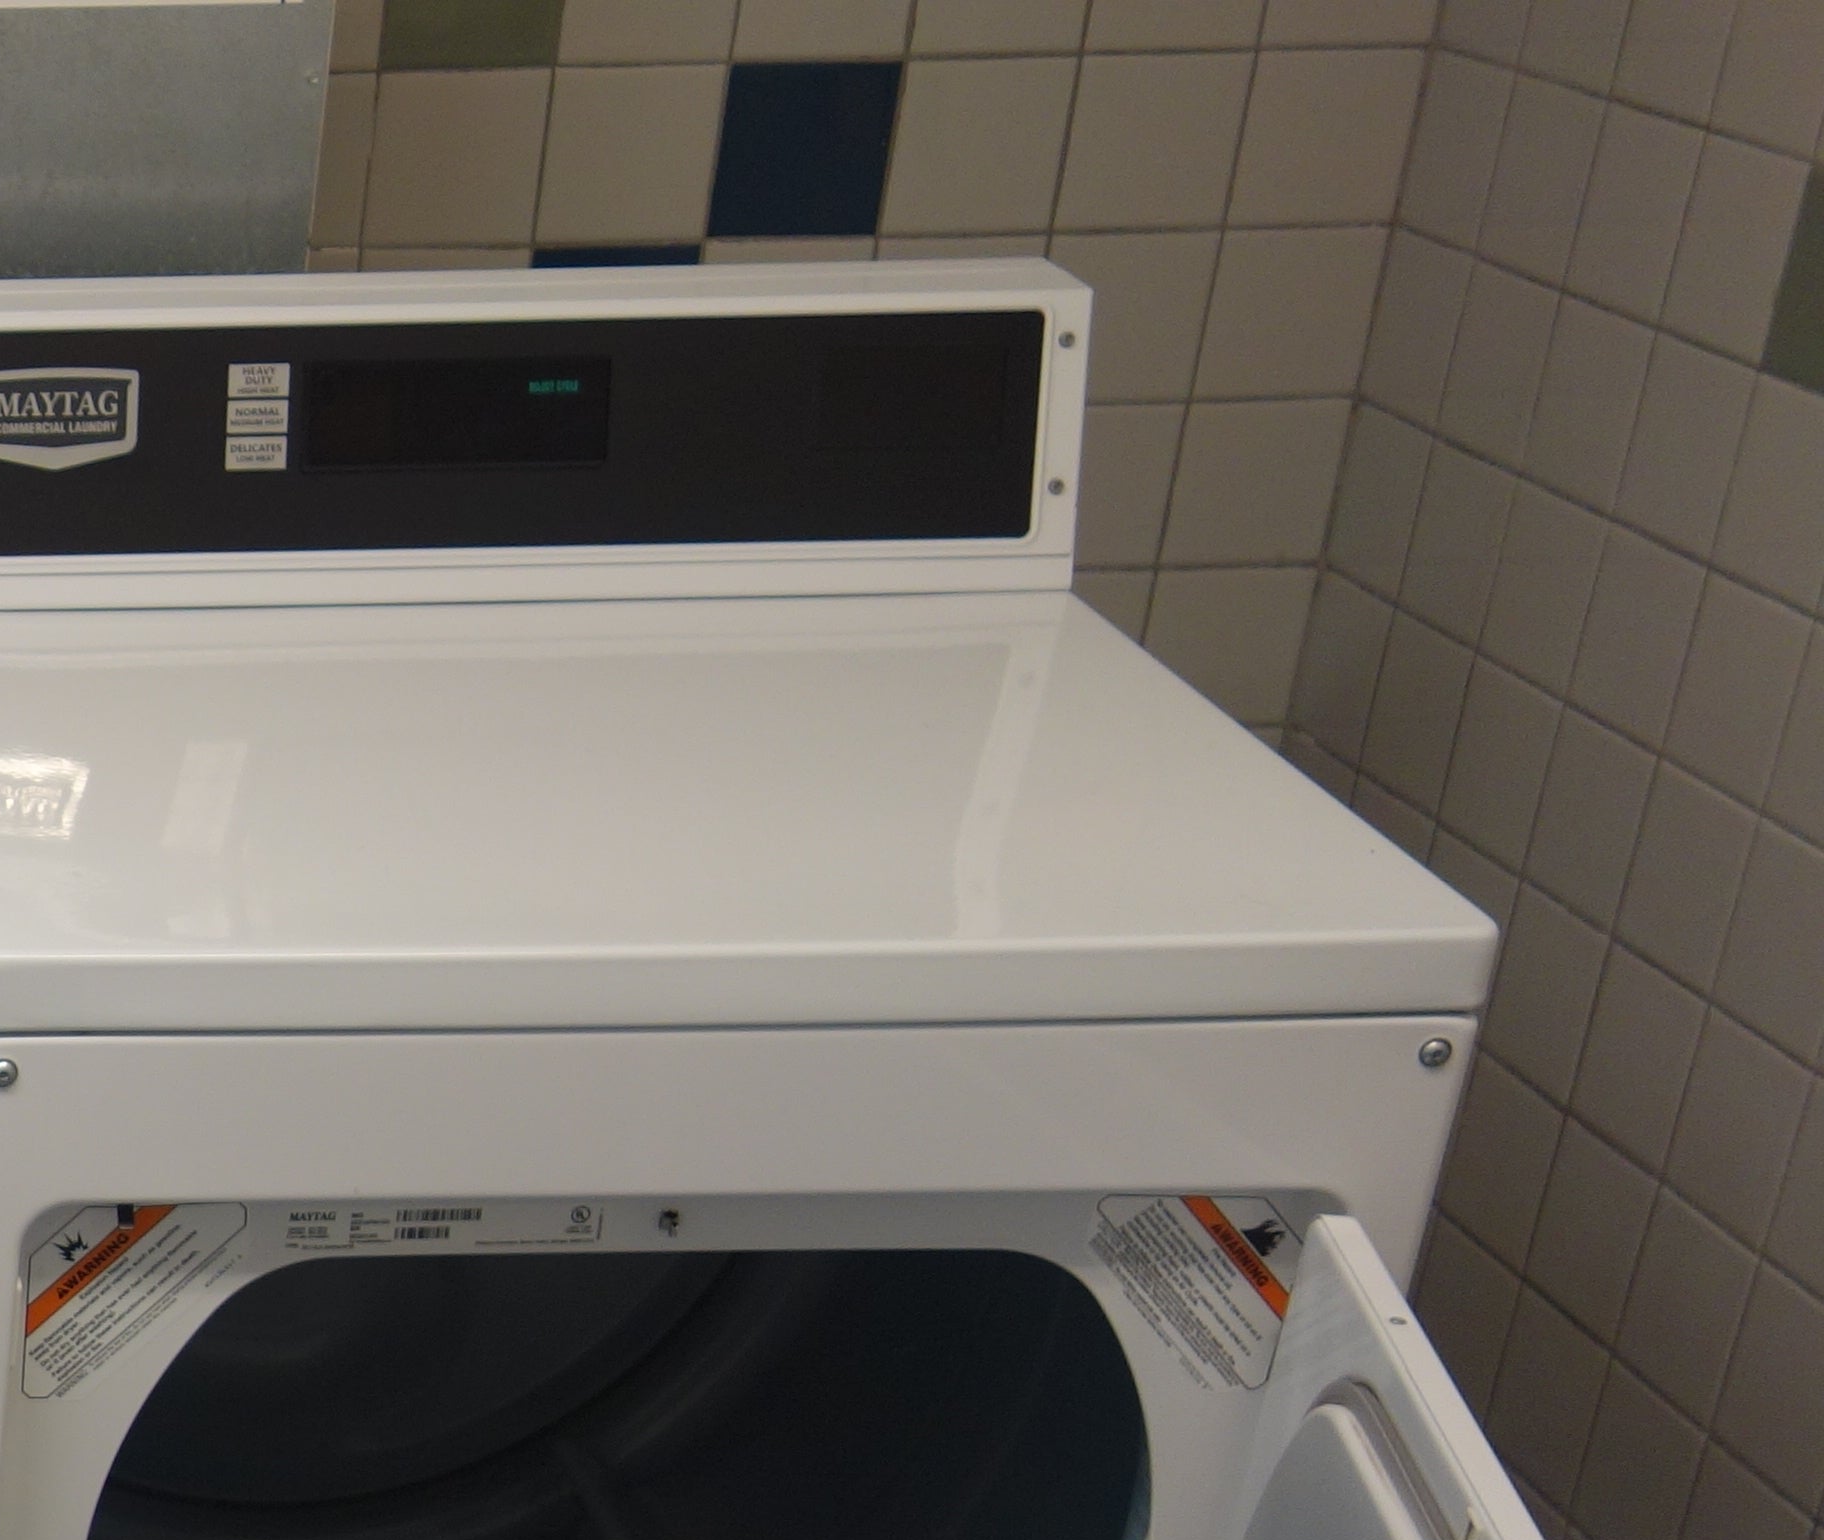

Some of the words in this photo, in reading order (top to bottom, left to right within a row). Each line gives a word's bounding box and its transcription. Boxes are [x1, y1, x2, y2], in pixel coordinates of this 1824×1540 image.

[242, 367, 275, 375] HEAVY
[245, 376, 273, 385] DUTY
[235, 407, 280, 416] NORMAL
[68, 420, 118, 434] LAUNDRY
[230, 443, 283, 453] DELICATES
[289, 1211, 336, 1221] MAYTAG
[64, 1231, 129, 1290] WARNING
[1217, 1228, 1269, 1288] WARNING
